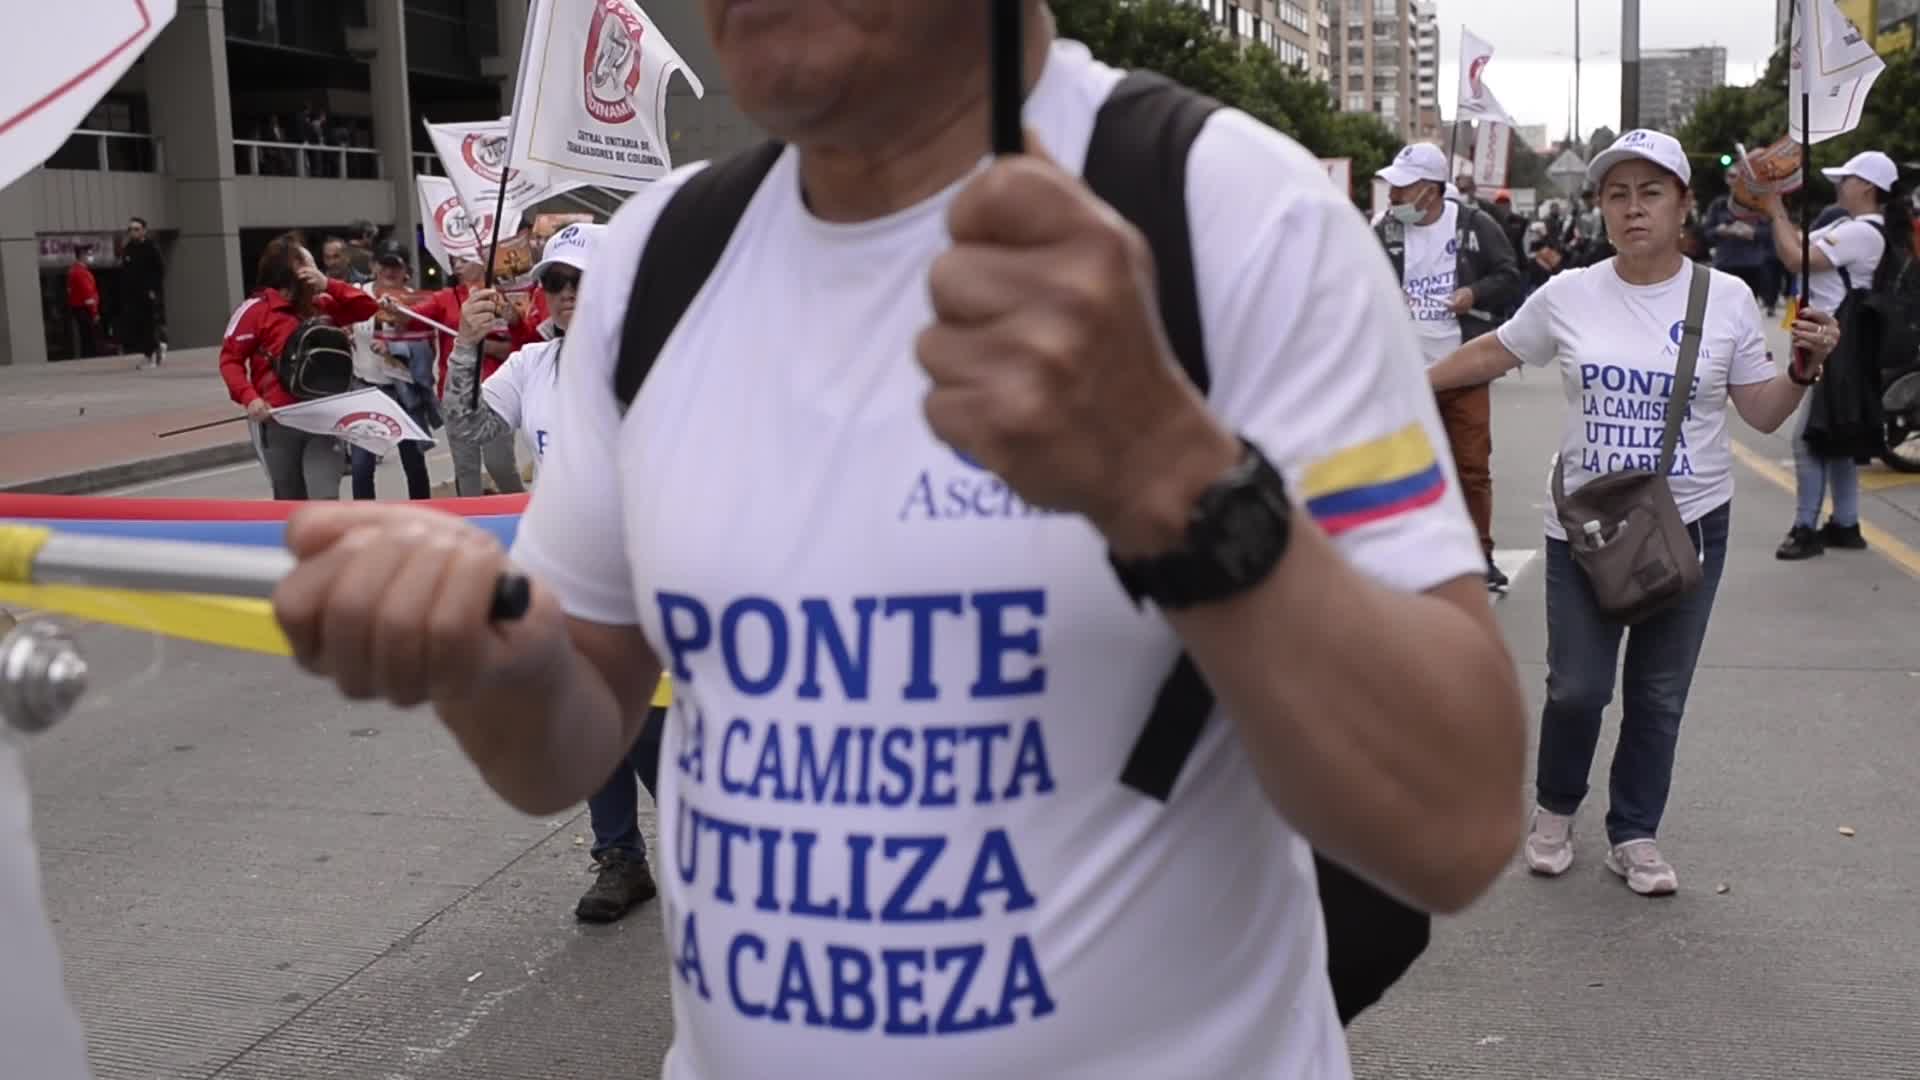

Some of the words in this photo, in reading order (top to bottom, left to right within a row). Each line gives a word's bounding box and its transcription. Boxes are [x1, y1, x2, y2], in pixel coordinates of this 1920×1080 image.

[1582, 394, 1599, 416] LA
[1603, 396, 1692, 422] CAMISA
[1581, 447, 1601, 473] LA
[655, 586, 1047, 701] PONTE
[719, 716, 1057, 808] CAMISETA
[675, 803, 1038, 923] UTILIZA
[674, 909, 711, 1001] A
[726, 931, 1057, 1037] CABEZA
